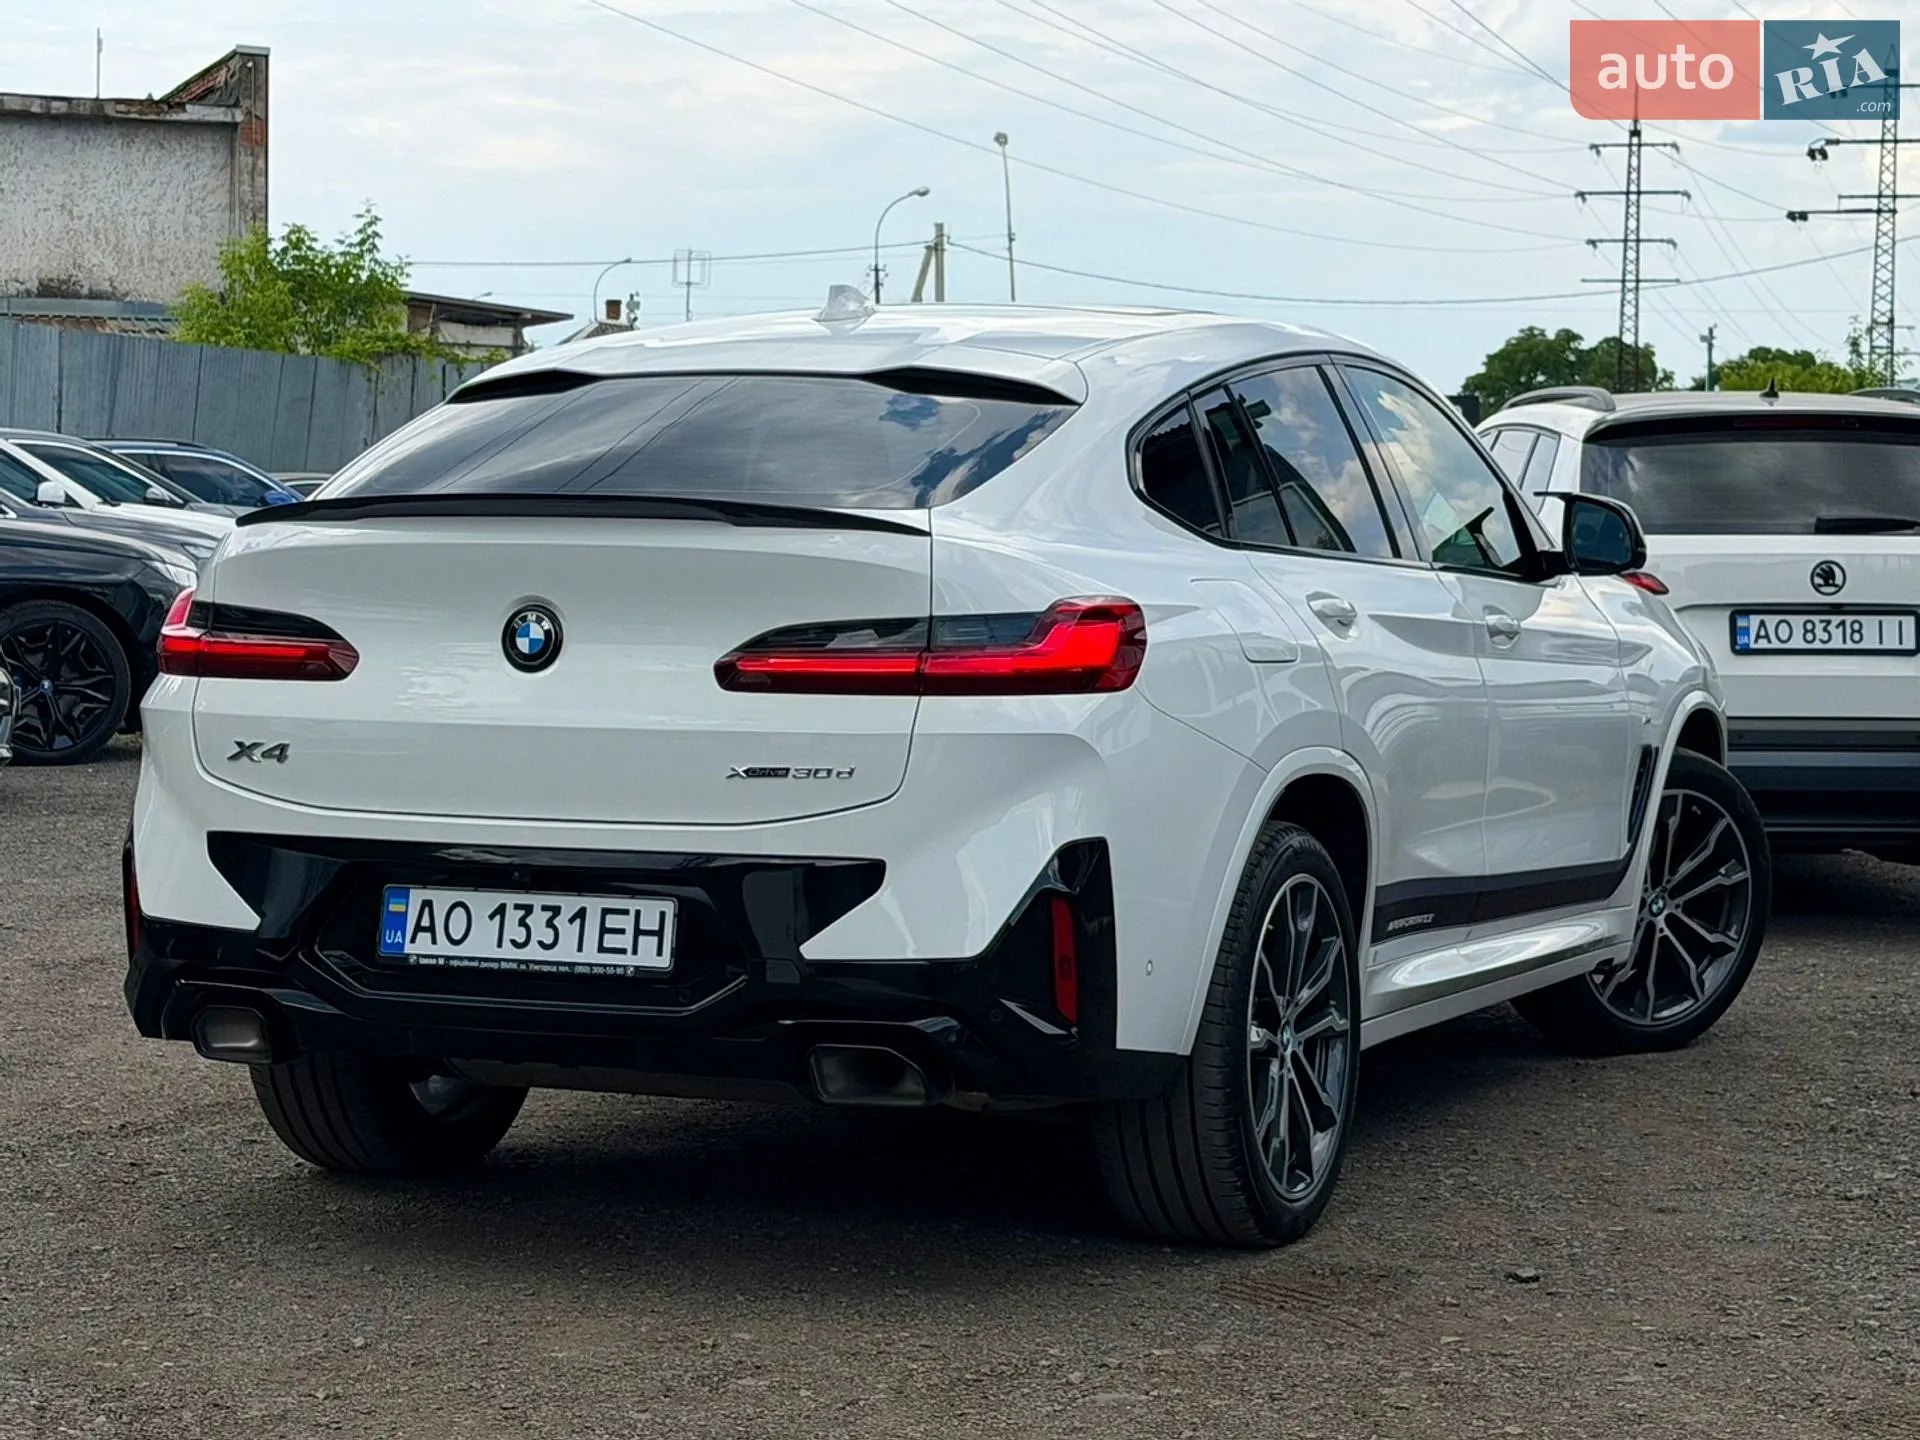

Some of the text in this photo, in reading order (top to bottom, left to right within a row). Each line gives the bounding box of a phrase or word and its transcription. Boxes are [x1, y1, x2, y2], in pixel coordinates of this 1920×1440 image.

[1753, 619, 1794, 645] AO
[1802, 619, 1865, 645] 8318
[226, 740, 291, 764] X4
[385, 929, 403, 944] UA
[409, 899, 667, 957] AO 1331 EH
